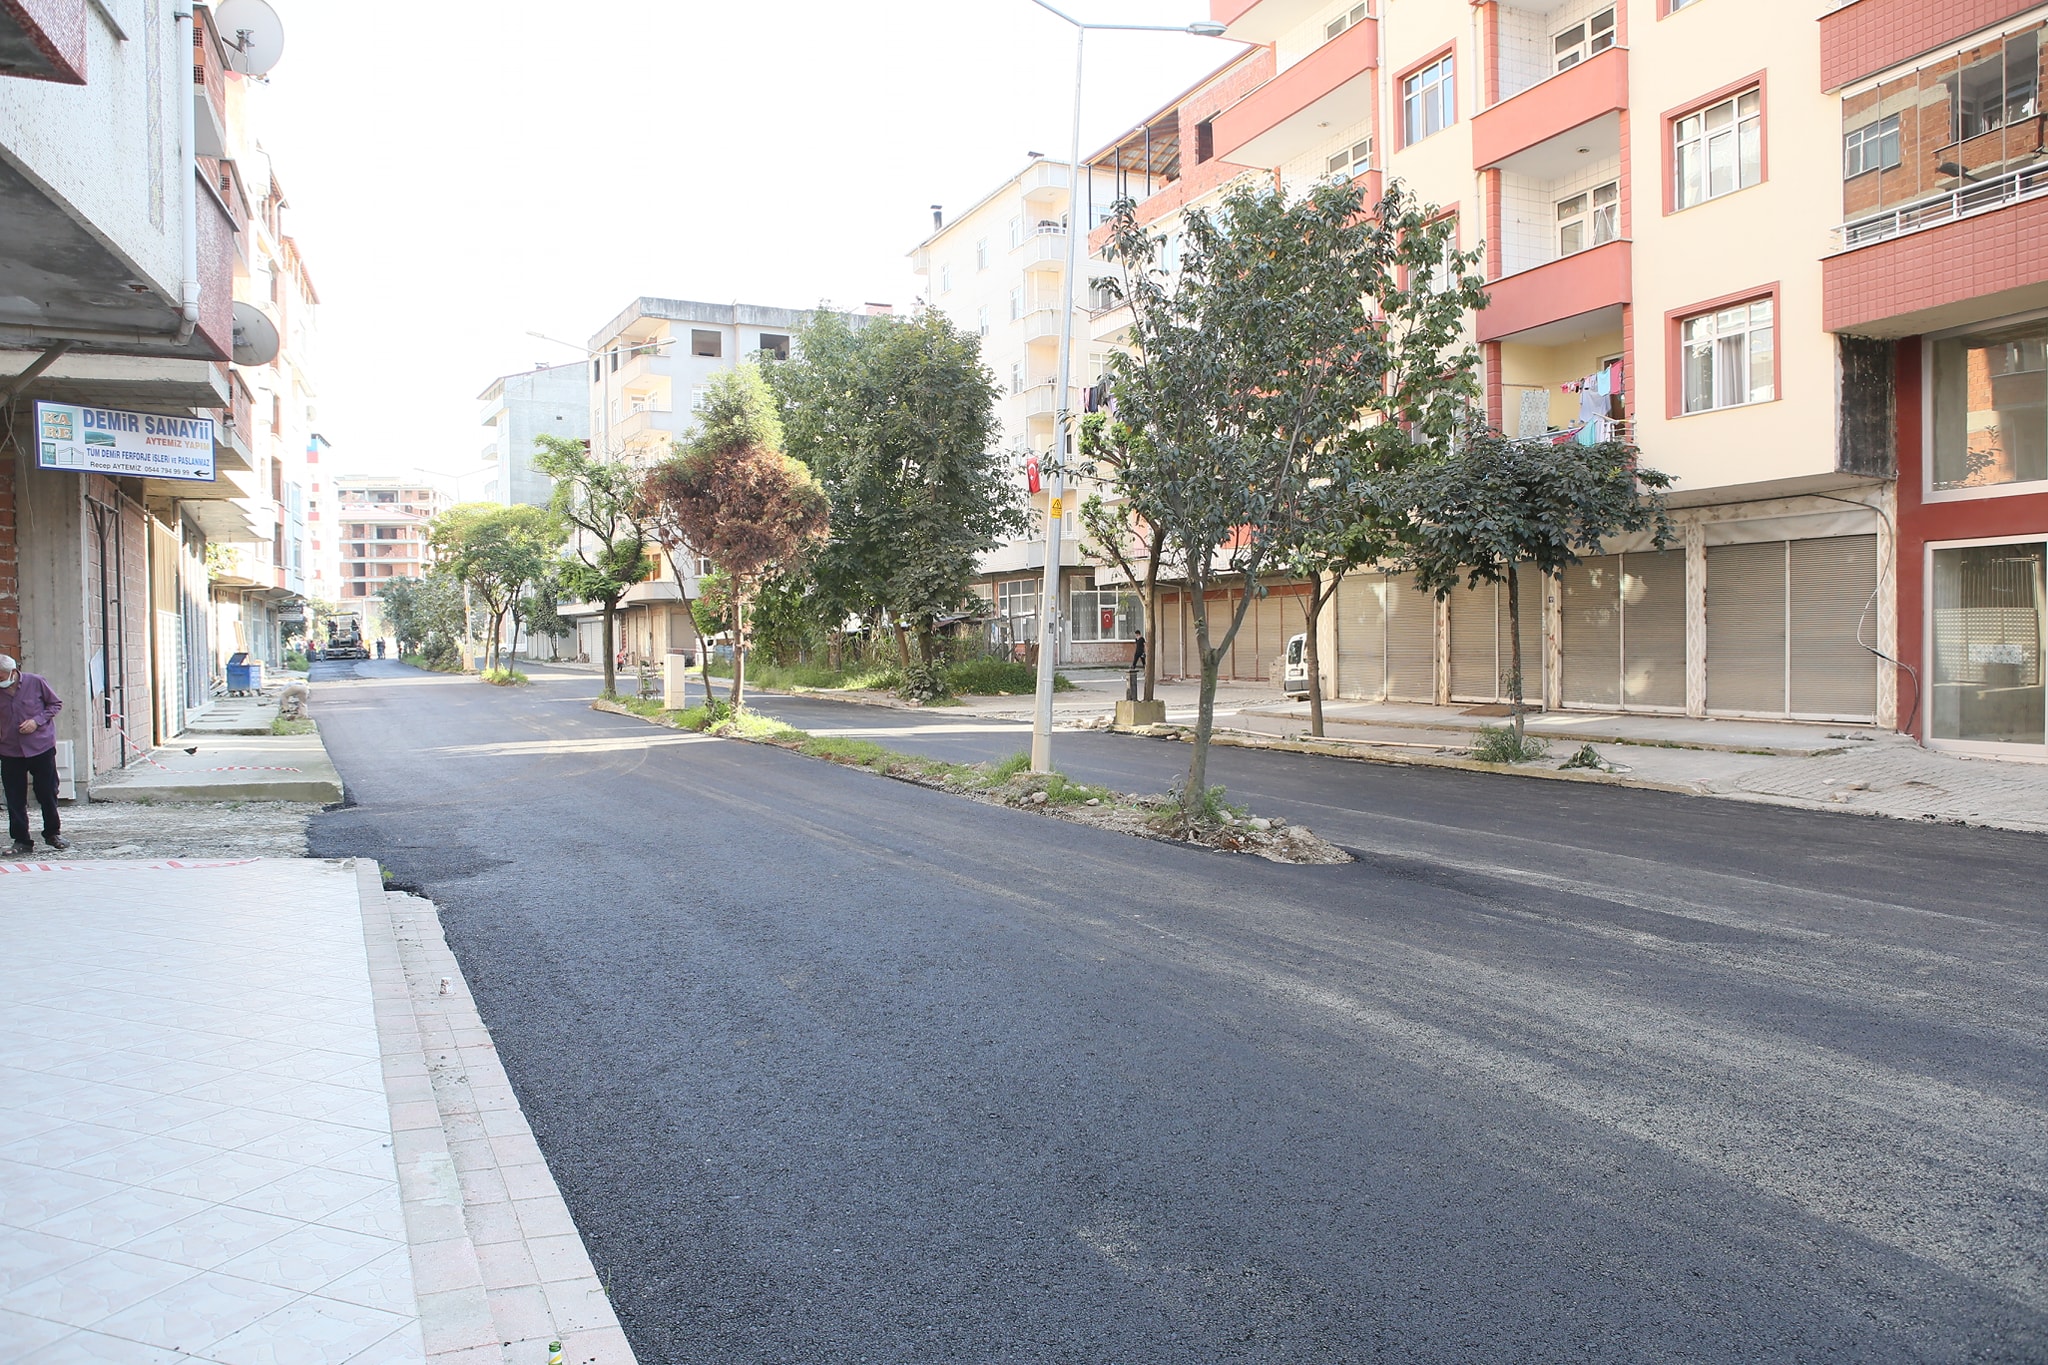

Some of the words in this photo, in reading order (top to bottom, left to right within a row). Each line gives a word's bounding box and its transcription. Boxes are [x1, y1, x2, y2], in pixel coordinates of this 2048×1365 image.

[43, 411, 71, 425] KA
[44, 426, 72, 440] RE
[184, 441, 210, 450] YAPIM
[86, 446, 100, 457] TÜM
[122, 450, 151, 462] FERFORJE
[178, 456, 210, 466] PASLANMAZ
[90, 461, 111, 470] Recep
